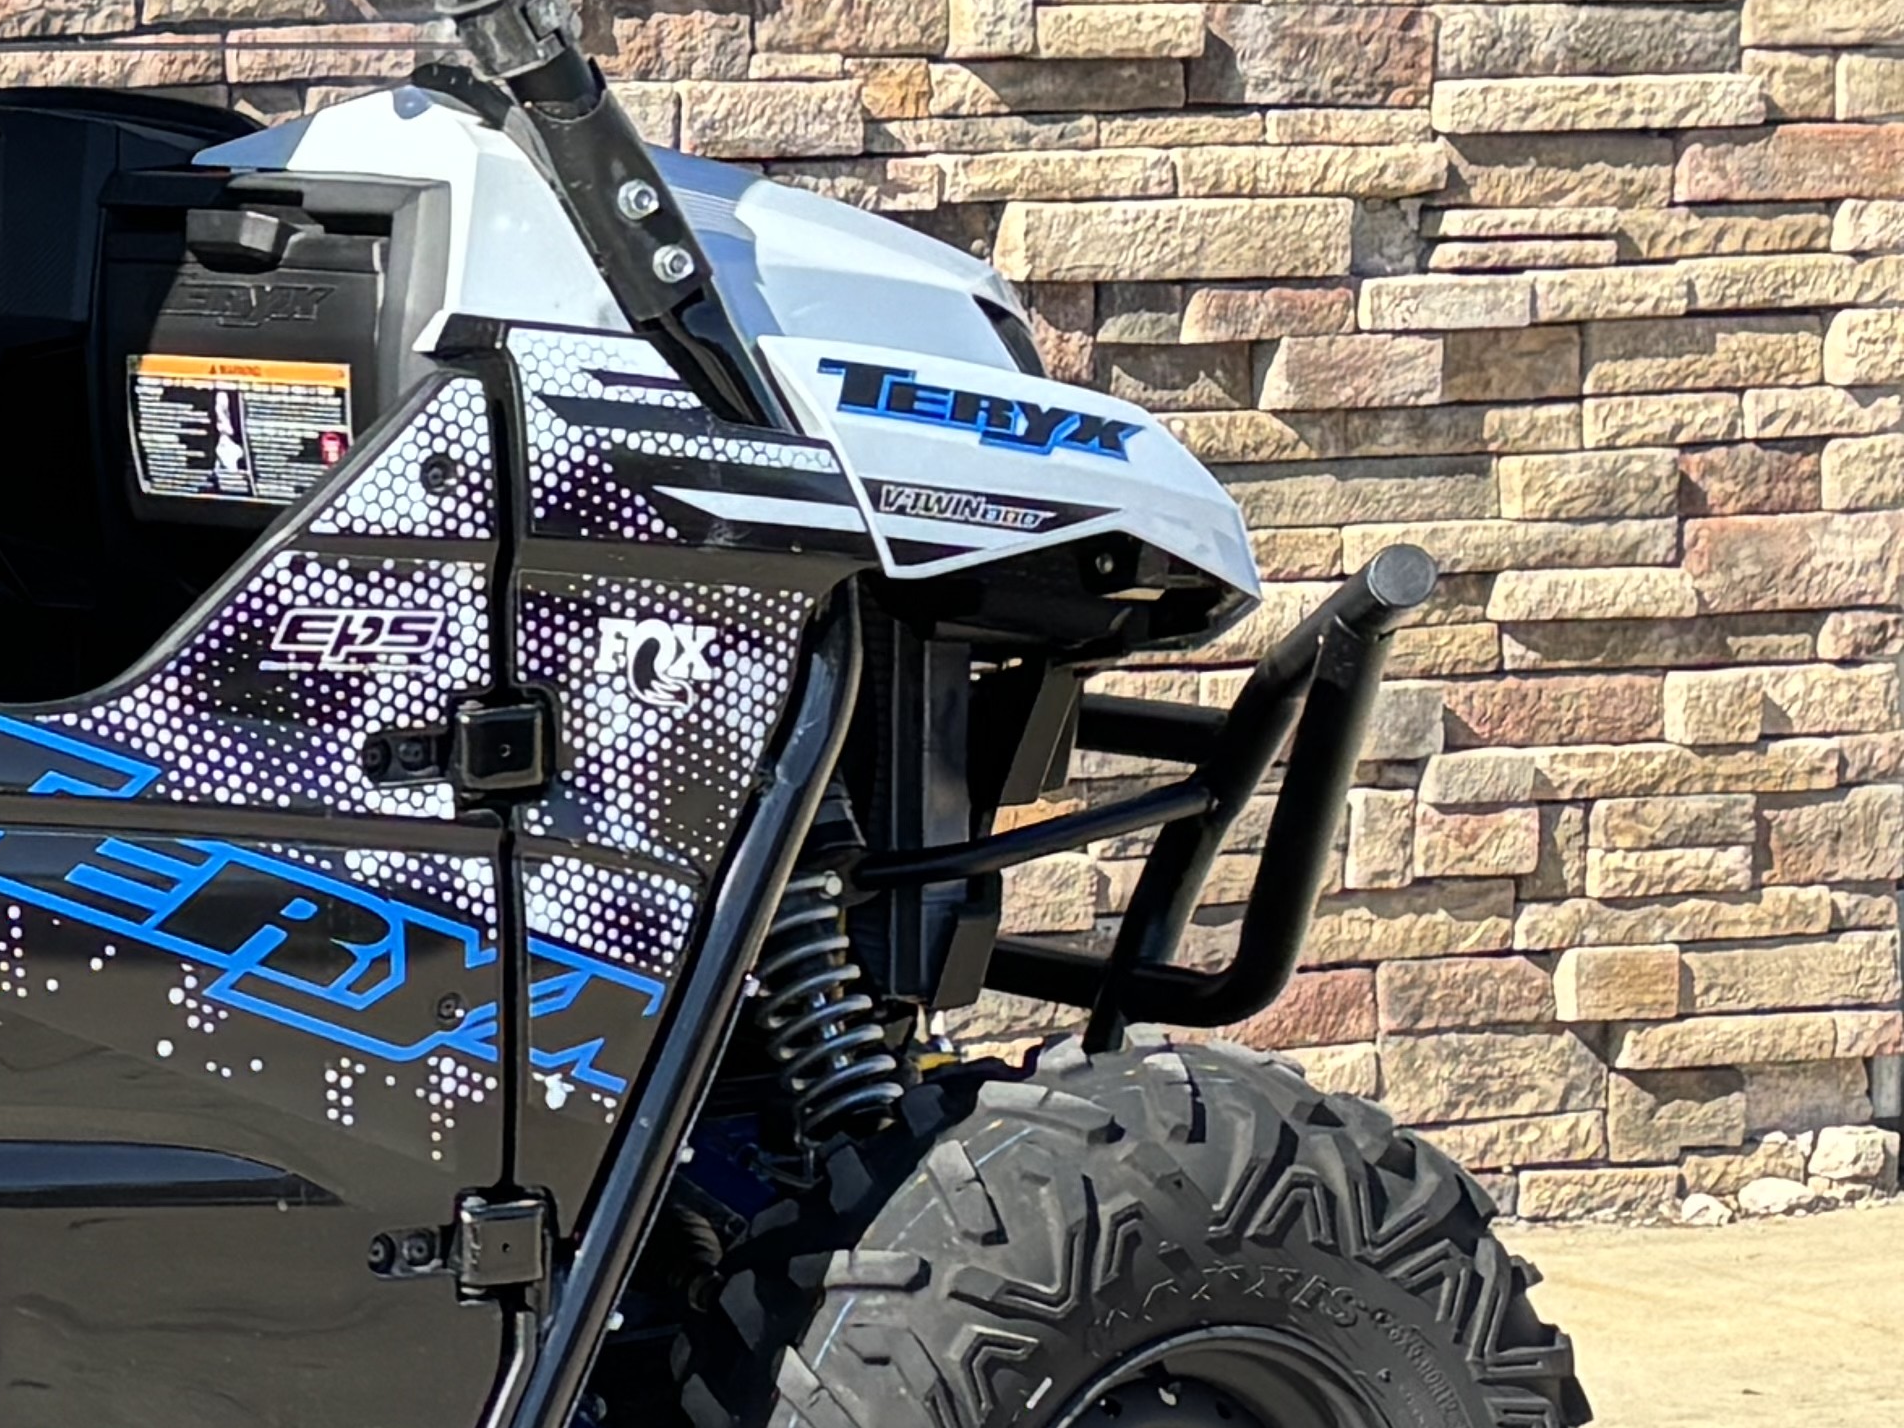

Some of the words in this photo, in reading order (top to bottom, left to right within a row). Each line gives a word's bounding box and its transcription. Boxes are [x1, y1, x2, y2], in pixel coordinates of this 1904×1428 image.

[817, 357, 1147, 463] TERYX
[270, 607, 446, 663] EPS
[593, 616, 718, 711] FOX
